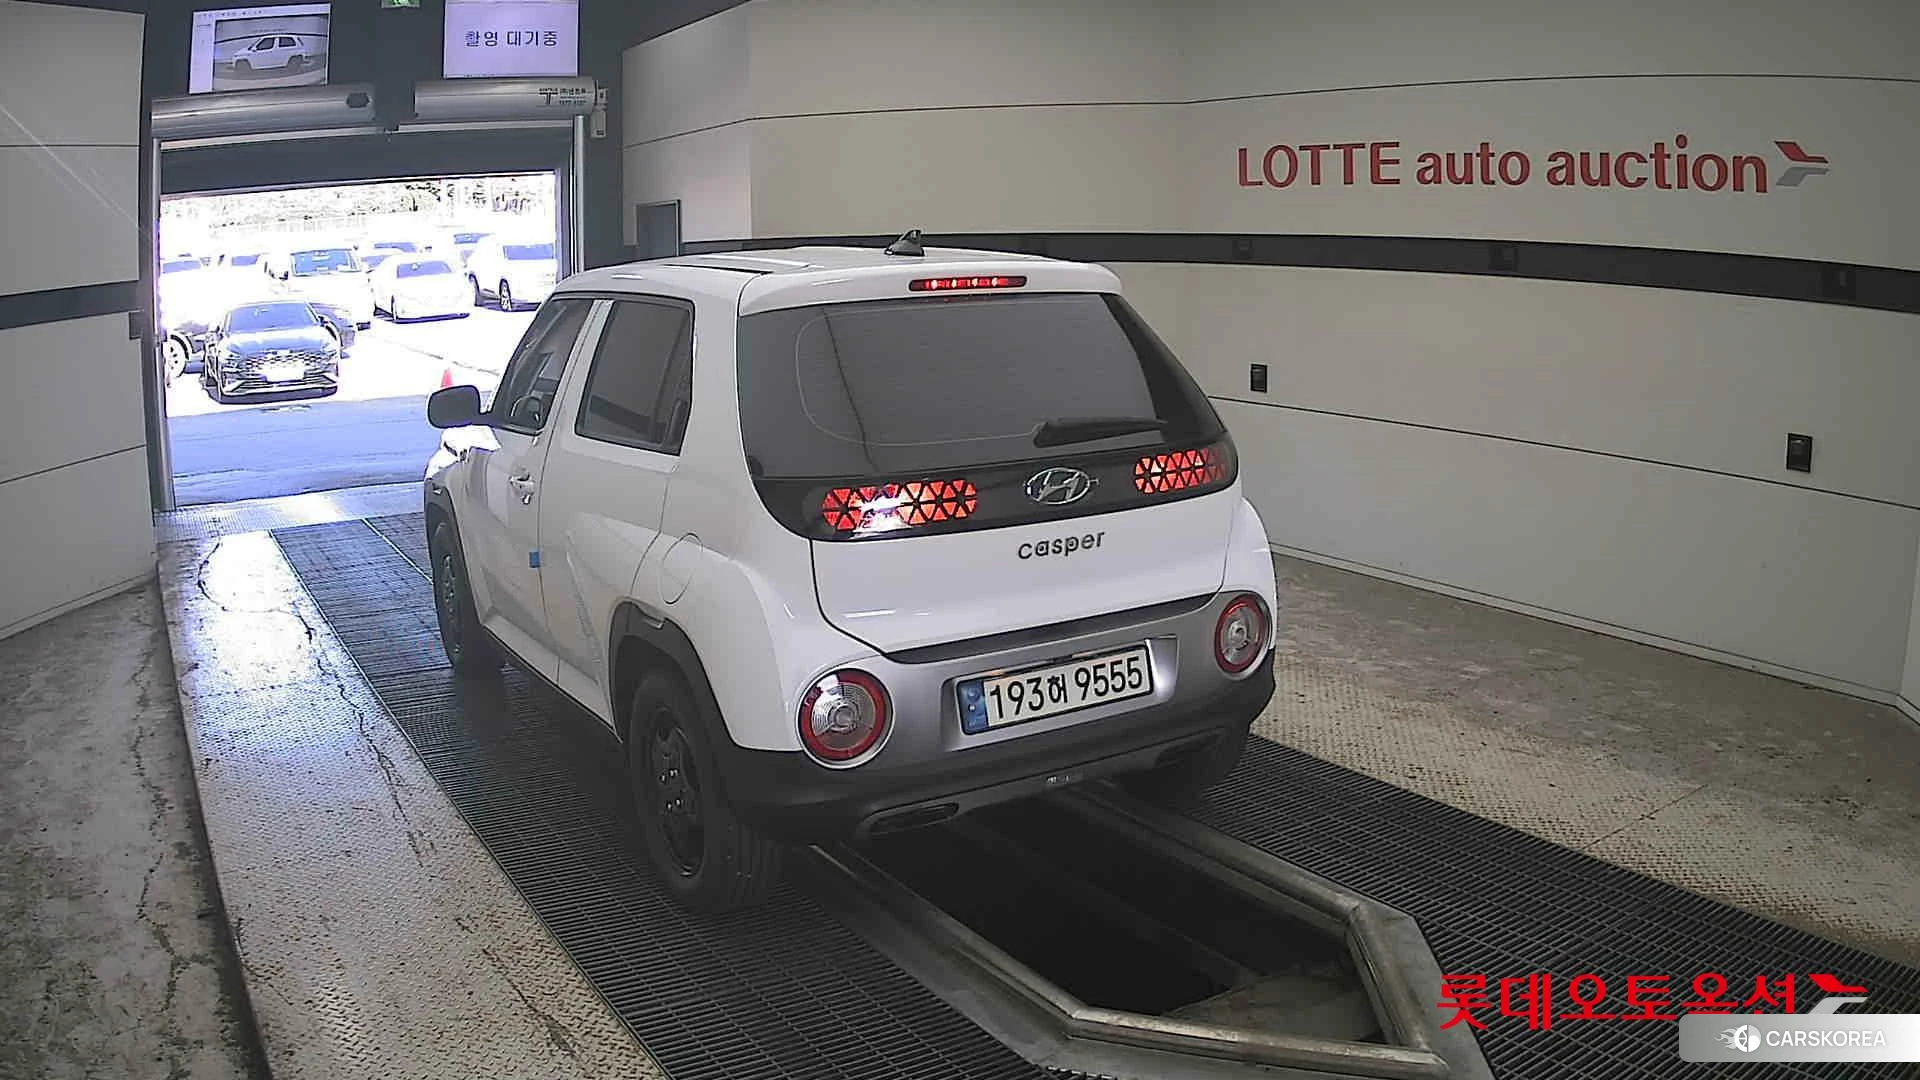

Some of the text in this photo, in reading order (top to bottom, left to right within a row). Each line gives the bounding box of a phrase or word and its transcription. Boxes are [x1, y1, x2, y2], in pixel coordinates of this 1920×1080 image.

[507, 31, 558, 47] 대기중
[1237, 134, 1769, 195] LOTTE auto auction
[1018, 531, 1106, 560] casper
[989, 655, 1143, 719] 193허 9555
